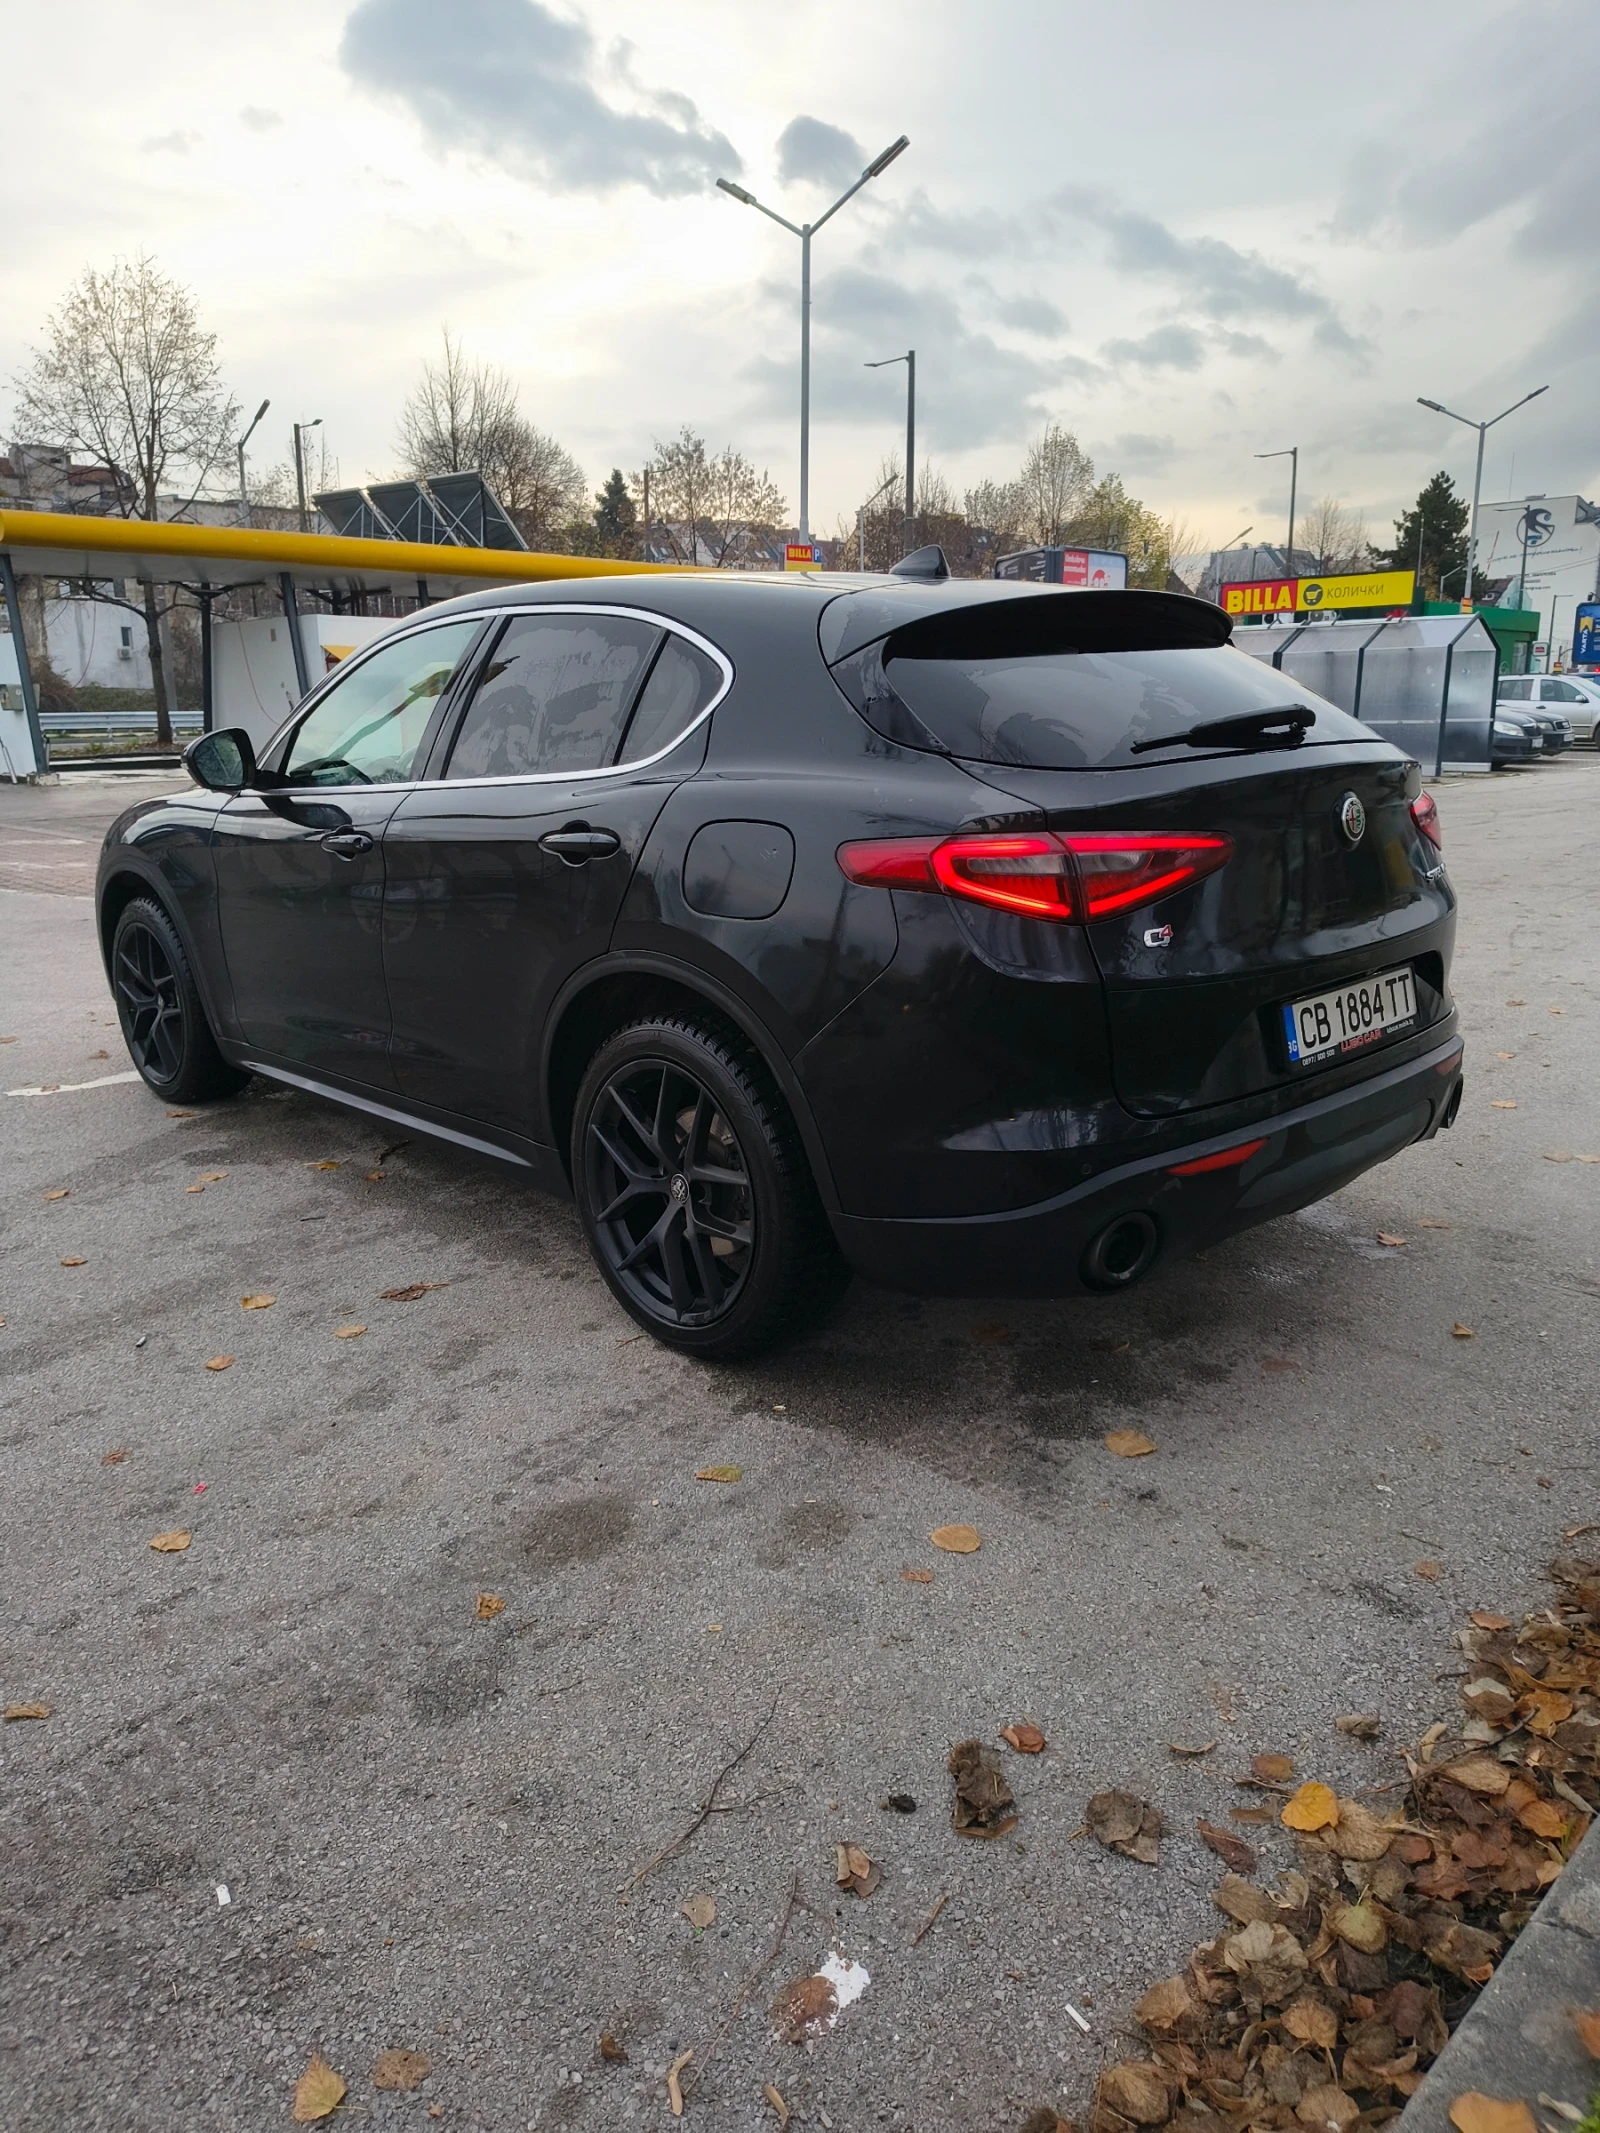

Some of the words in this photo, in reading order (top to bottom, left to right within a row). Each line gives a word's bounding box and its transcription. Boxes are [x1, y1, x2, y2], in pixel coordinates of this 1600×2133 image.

[788, 547, 812, 559] BILLA
[814, 548, 820, 560] P
[1227, 585, 1292, 614] BILLA
[1326, 584, 1384, 599] КОЛИЧКИ
[1580, 628, 1588, 654] VARTA
[1299, 1002, 1331, 1048] CB
[1336, 983, 1384, 1036] 1884
[1385, 974, 1409, 1017] TT
